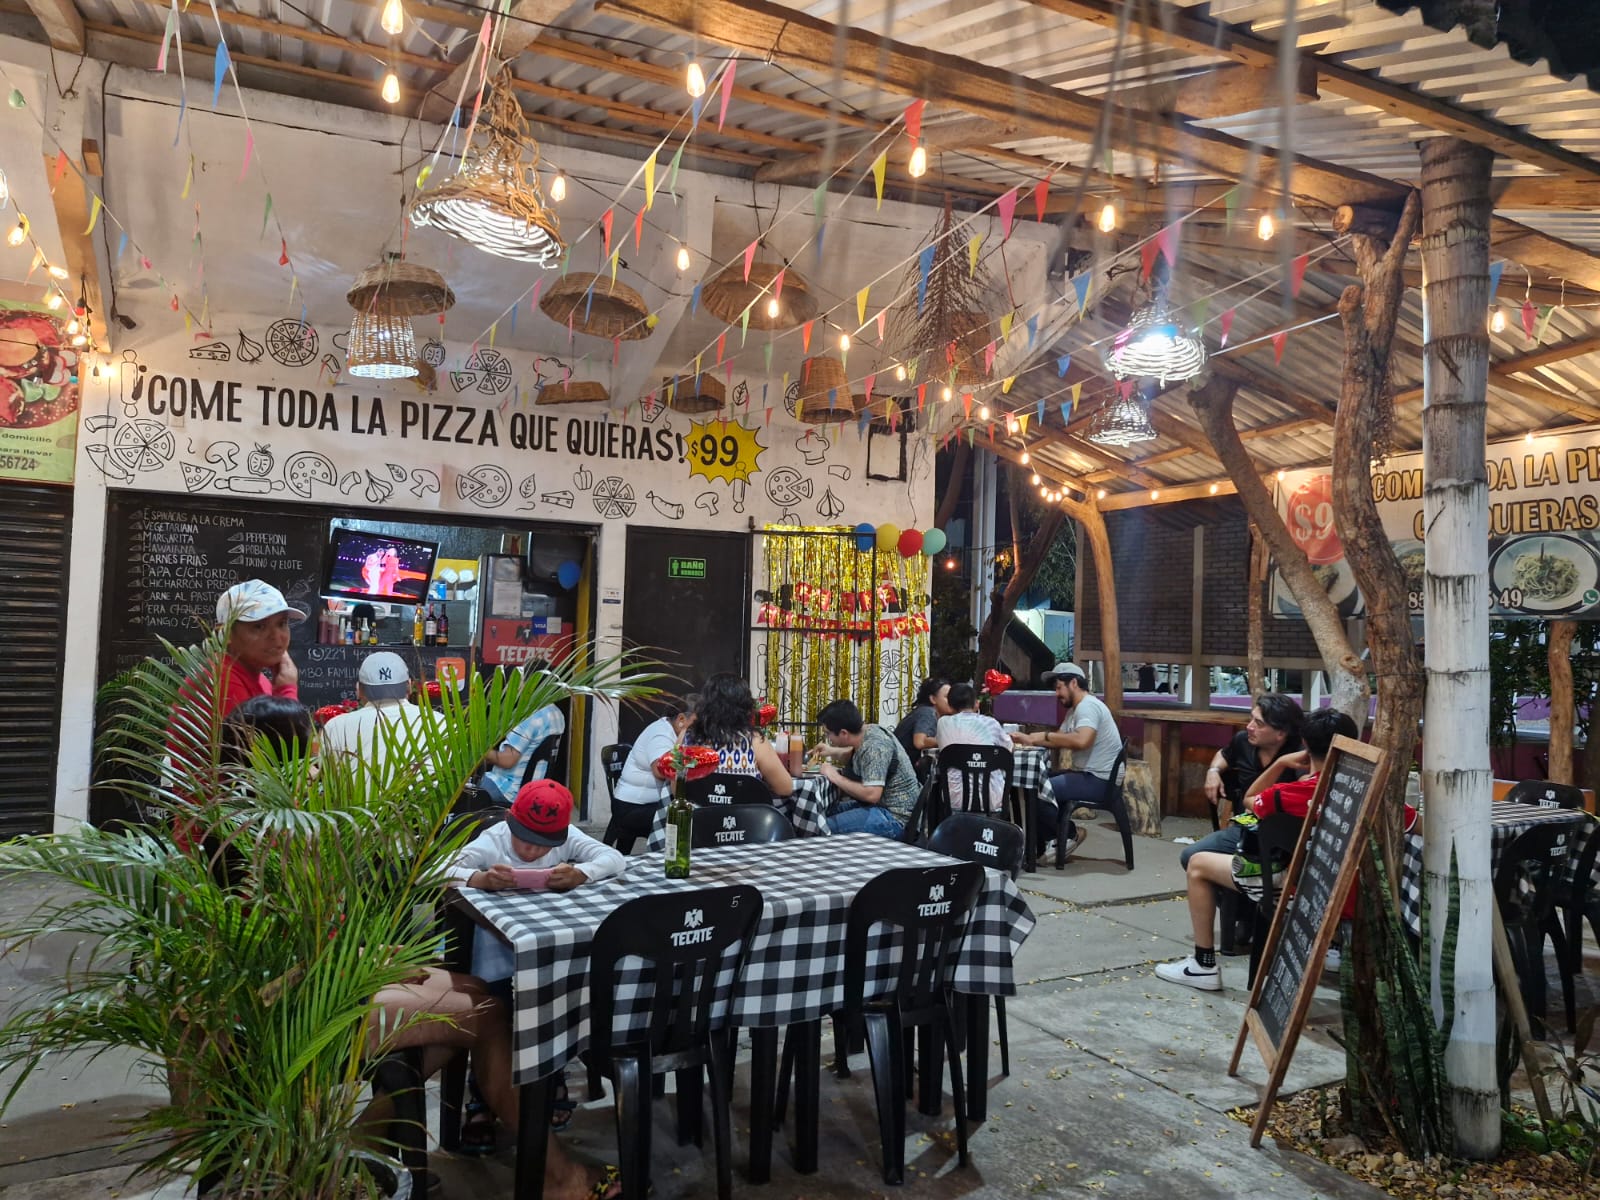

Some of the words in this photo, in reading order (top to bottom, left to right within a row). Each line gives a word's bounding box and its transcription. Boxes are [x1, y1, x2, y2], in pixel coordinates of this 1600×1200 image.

[257, 385, 339, 432] TODA
[351, 395, 387, 436] LA
[401, 400, 499, 447] PIZZA
[510, 412, 559, 453] QUE
[566, 418, 686, 464] QUIERAS!
[1, 433, 52, 443] domicilio
[23, 449, 53, 457] llevar
[691, 434, 739, 467] $99
[1370, 469, 1423, 503] COM
[1486, 457, 1518, 492] DA
[1524, 452, 1560, 488] LA
[1566, 446, 1600, 484] PI
[144, 508, 188, 521] ESPINACAS
[212, 515, 245, 528] CREMA
[1294, 501, 1336, 545] $9
[143, 521, 199, 534] VEGETARIANA
[143, 531, 194, 544] MARGARITA
[245, 532, 287, 546] PEPPERONI
[245, 544, 287, 556] POBLANA
[142, 552, 178, 565] CARNES
[279, 559, 303, 570] ELOTE
[143, 564, 171, 577] PAPA
[207, 580, 233, 590] PREN
[142, 590, 171, 601] CARNE
[174, 592, 187, 601] AL
[191, 592, 220, 602] PASTO
[1499, 587, 1524, 609] 49
[141, 602, 166, 614] PERA
[141, 615, 178, 627] MANGO
[496, 645, 555, 663] TECATE
[707, 794, 733, 805] TECATE
[714, 830, 746, 842] TECATE
[973, 841, 1000, 857] TECATE
[917, 901, 952, 917] TECATE
[670, 926, 715, 947] TECATE
